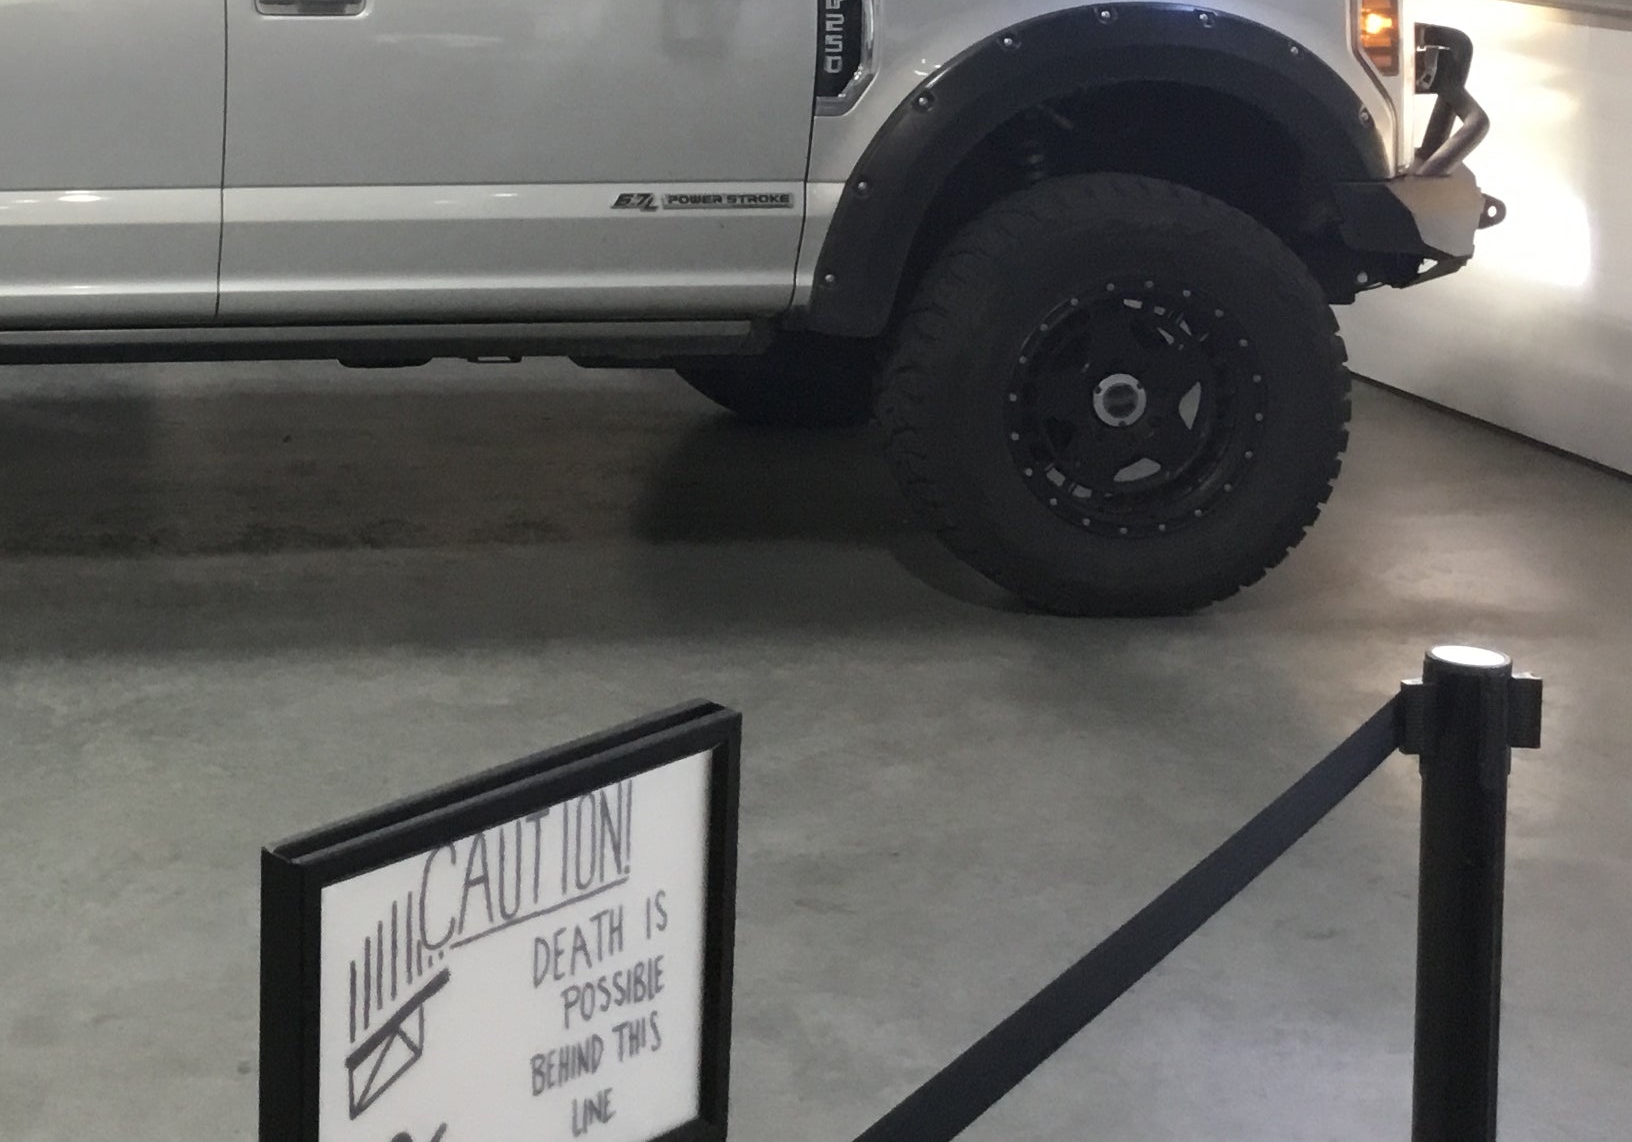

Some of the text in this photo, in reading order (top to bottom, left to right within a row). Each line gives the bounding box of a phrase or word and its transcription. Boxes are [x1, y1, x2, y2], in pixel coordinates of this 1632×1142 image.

[667, 194, 723, 205] POWER
[726, 194, 790, 204] STROKE
[419, 780, 633, 949] CAUTION!
[533, 889, 668, 989] DEATH IS
[560, 954, 665, 1030] POSSIBLE
[529, 1010, 662, 1097] BEHIND THIS
[571, 1087, 617, 1138] LINE
